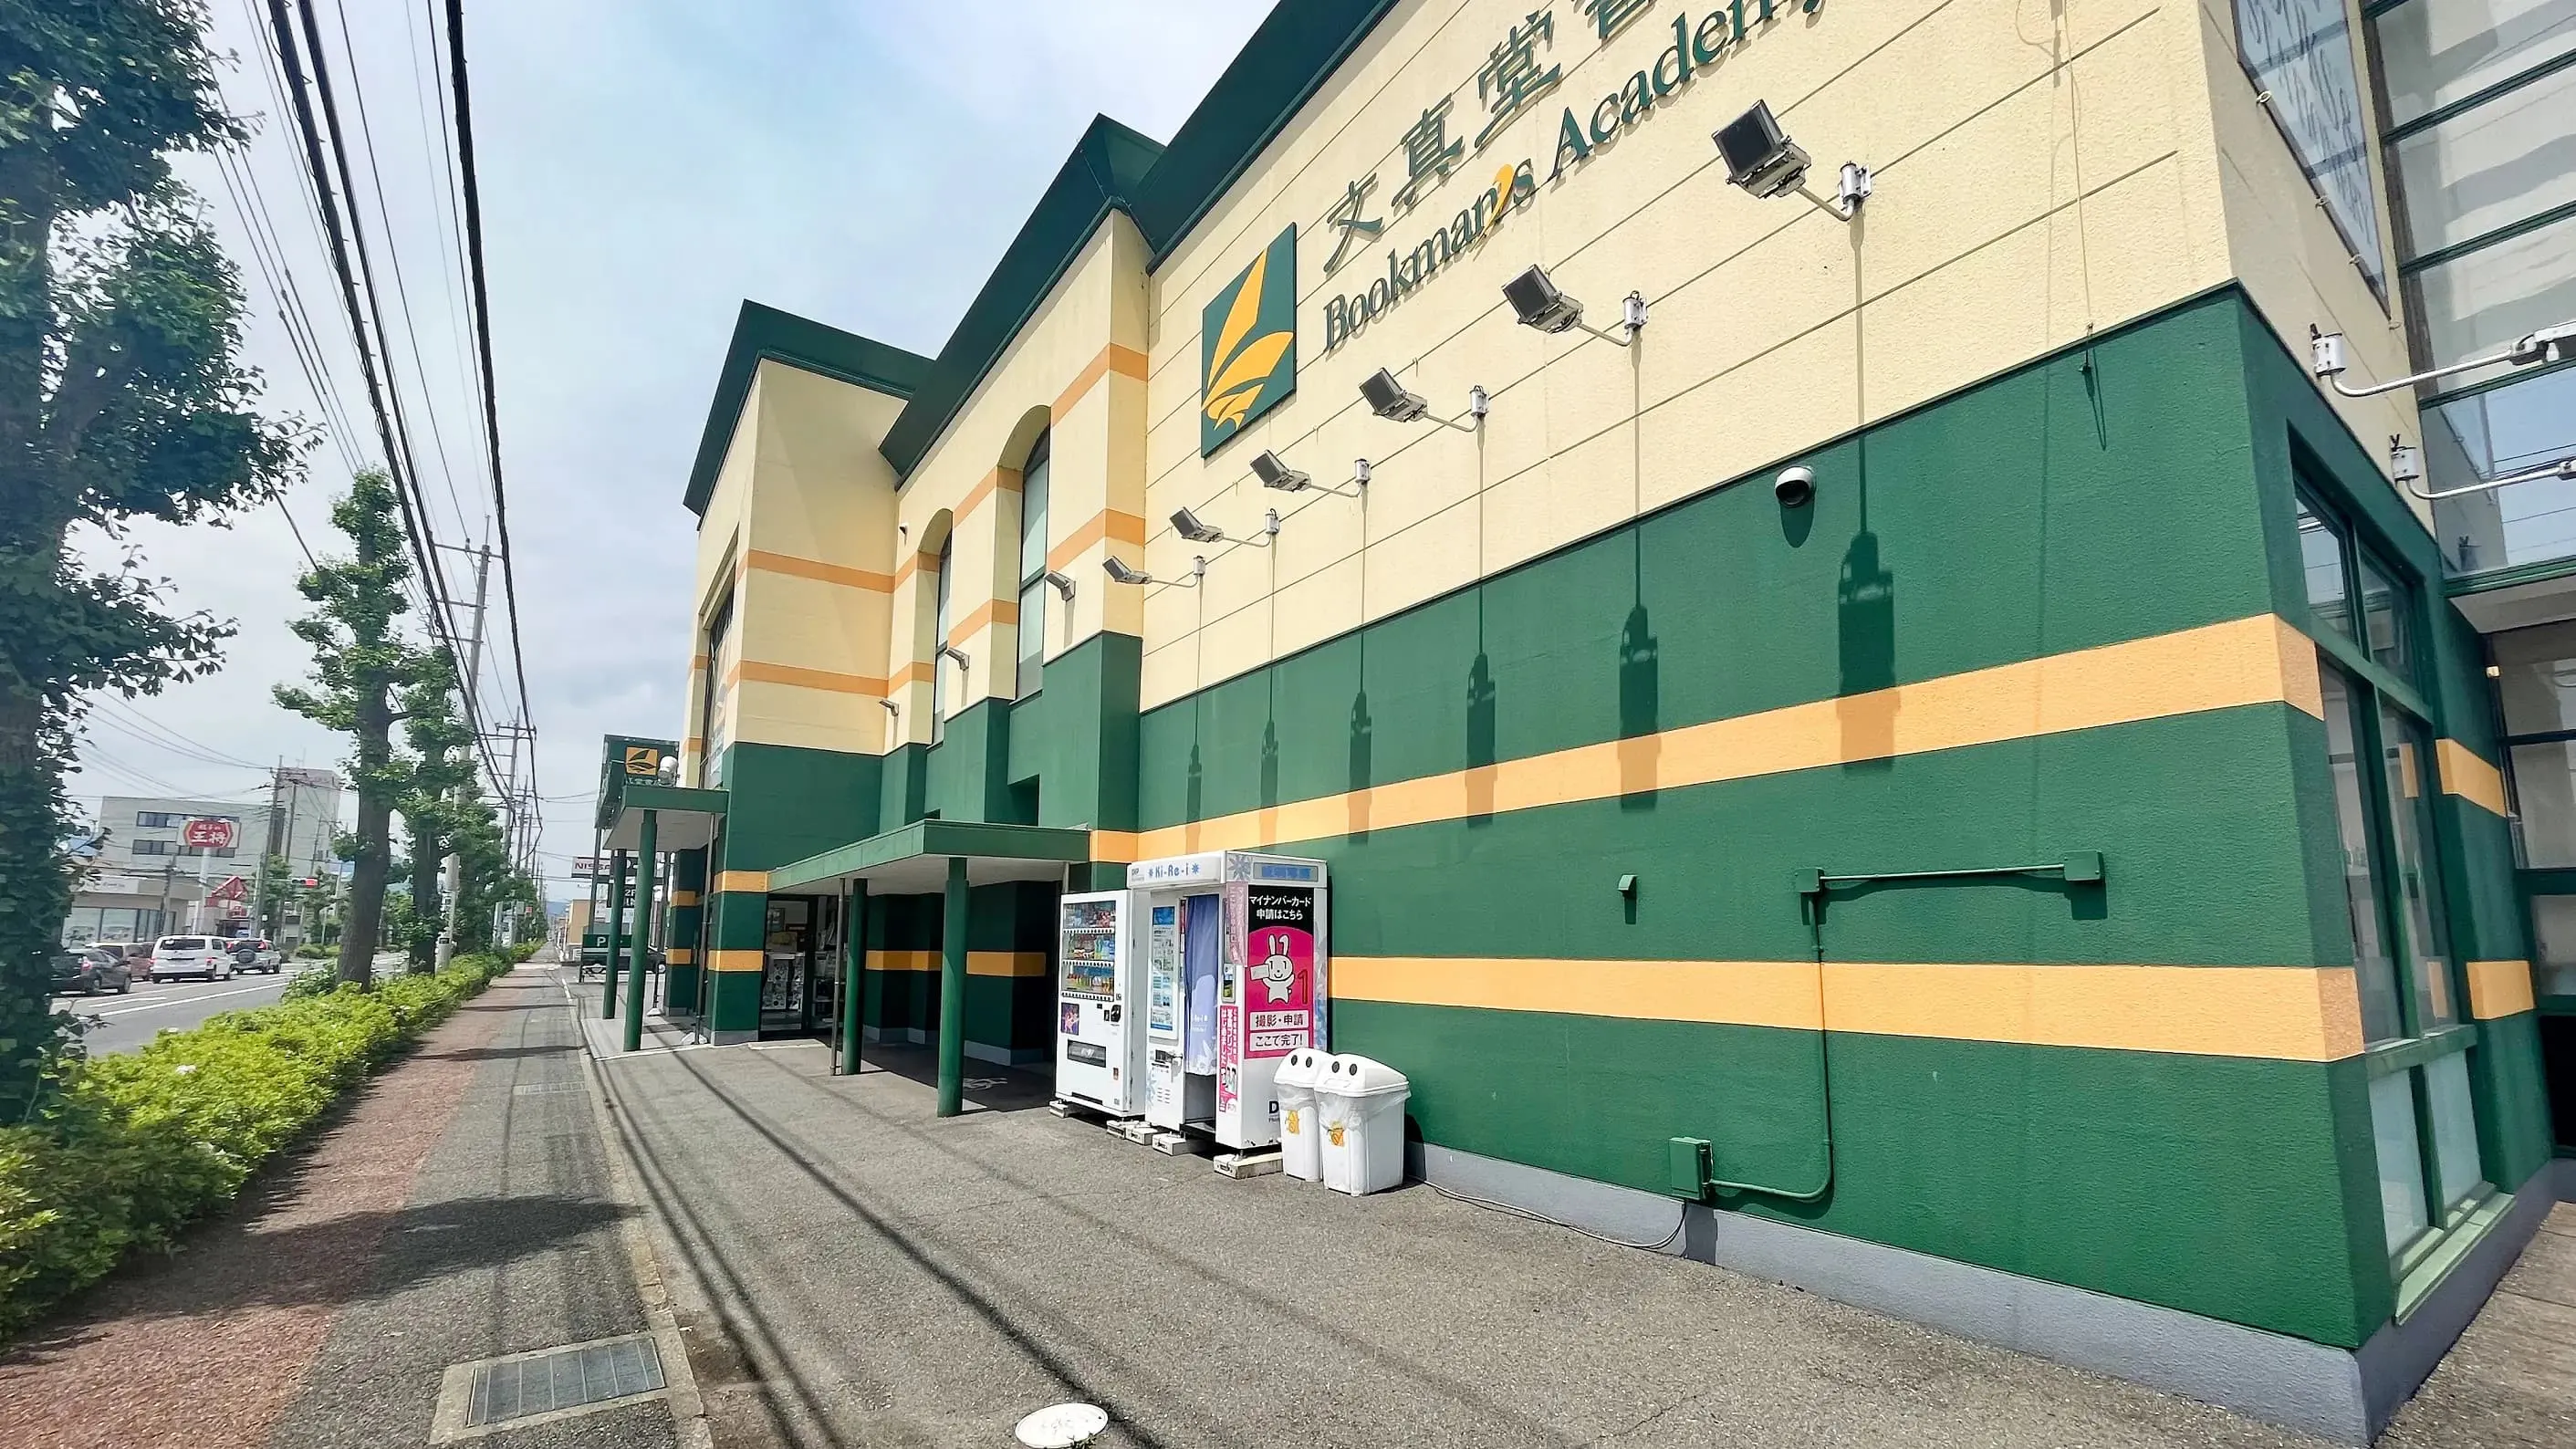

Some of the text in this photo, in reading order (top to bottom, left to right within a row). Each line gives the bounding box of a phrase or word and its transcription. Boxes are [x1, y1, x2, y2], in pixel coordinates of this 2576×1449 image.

[1323, 0, 1823, 355] Bookman's Acade
[190, 831, 226, 844] 王将
[1249, 895, 1312, 907] マイナンバーカード
[1257, 909, 1303, 920] 申請はこちら
[1255, 1014, 1303, 1027] 撮影・申請
